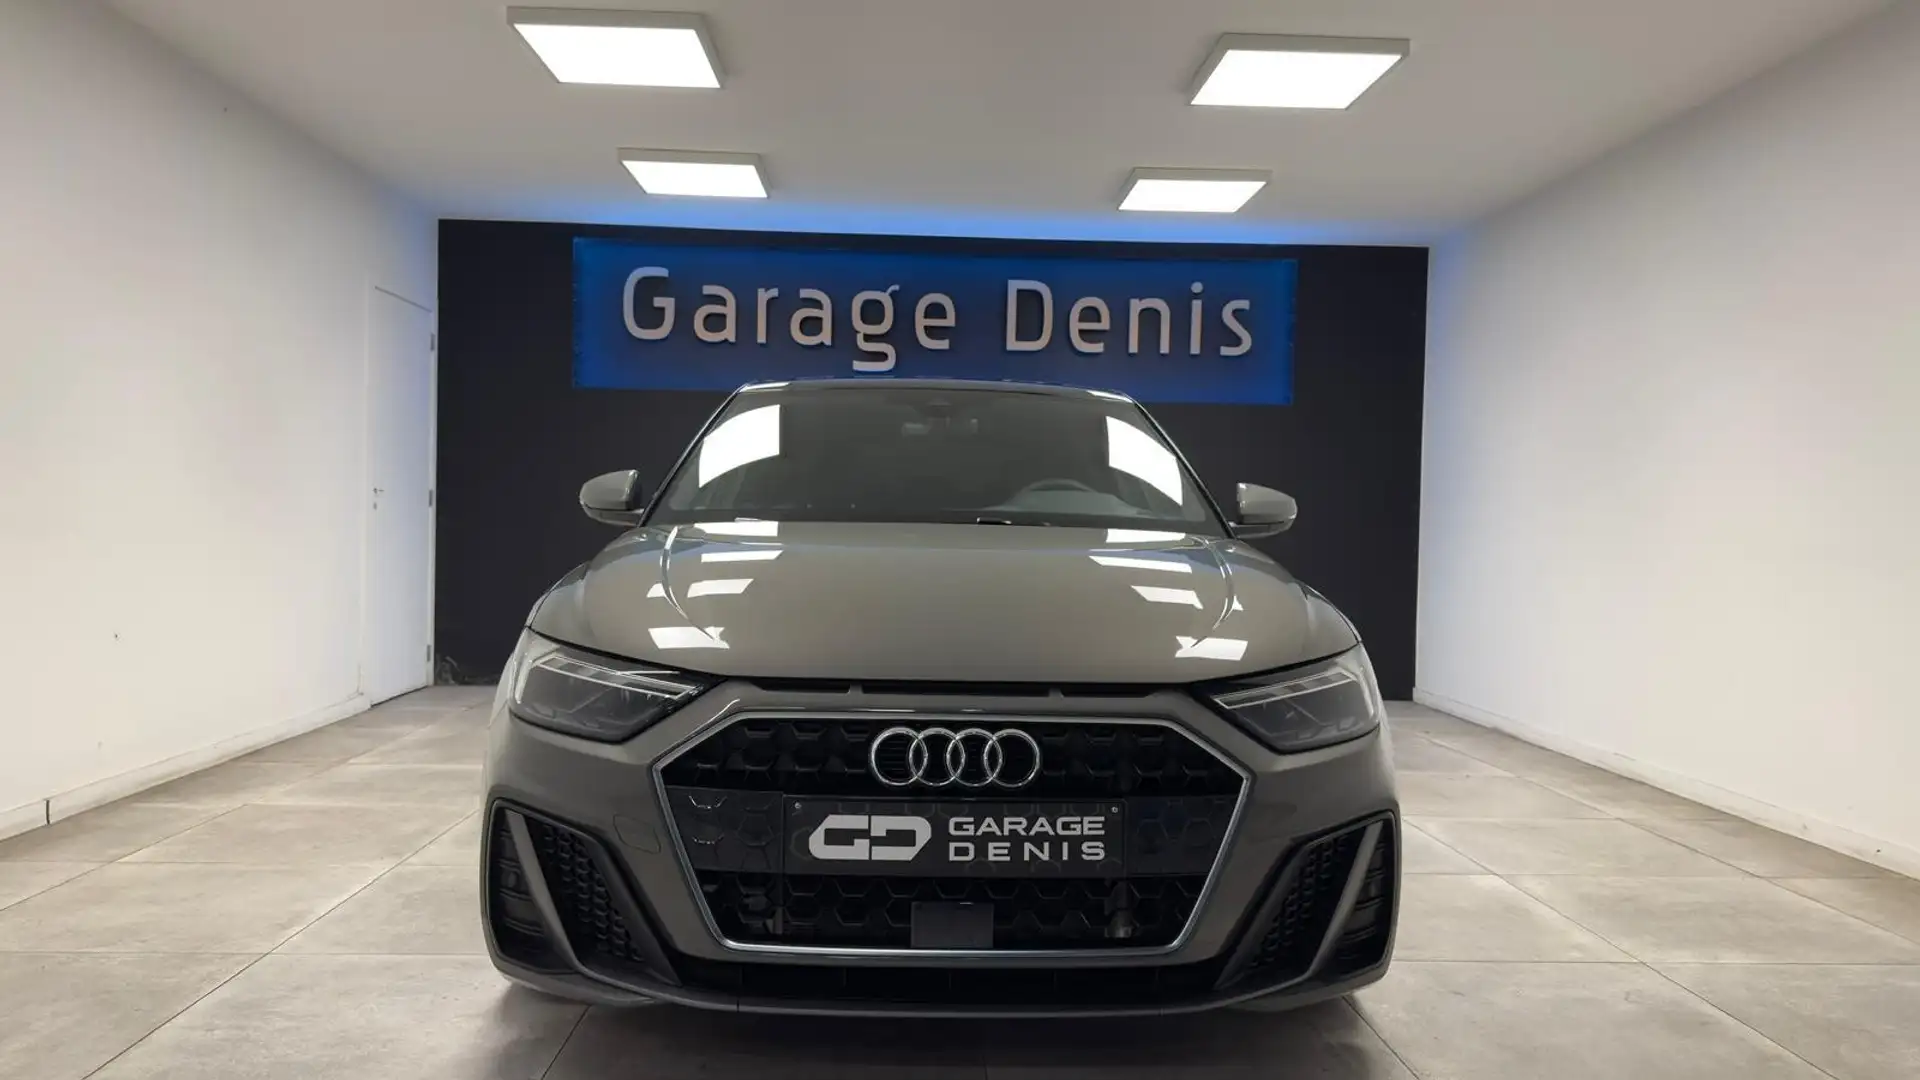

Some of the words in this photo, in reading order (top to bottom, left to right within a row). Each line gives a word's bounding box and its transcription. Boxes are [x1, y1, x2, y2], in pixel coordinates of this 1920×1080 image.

[622, 266, 956, 372] Garage
[1005, 279, 1251, 357] Denis
[948, 816, 1106, 836] GARAGE
[948, 841, 1106, 862] DENIS
